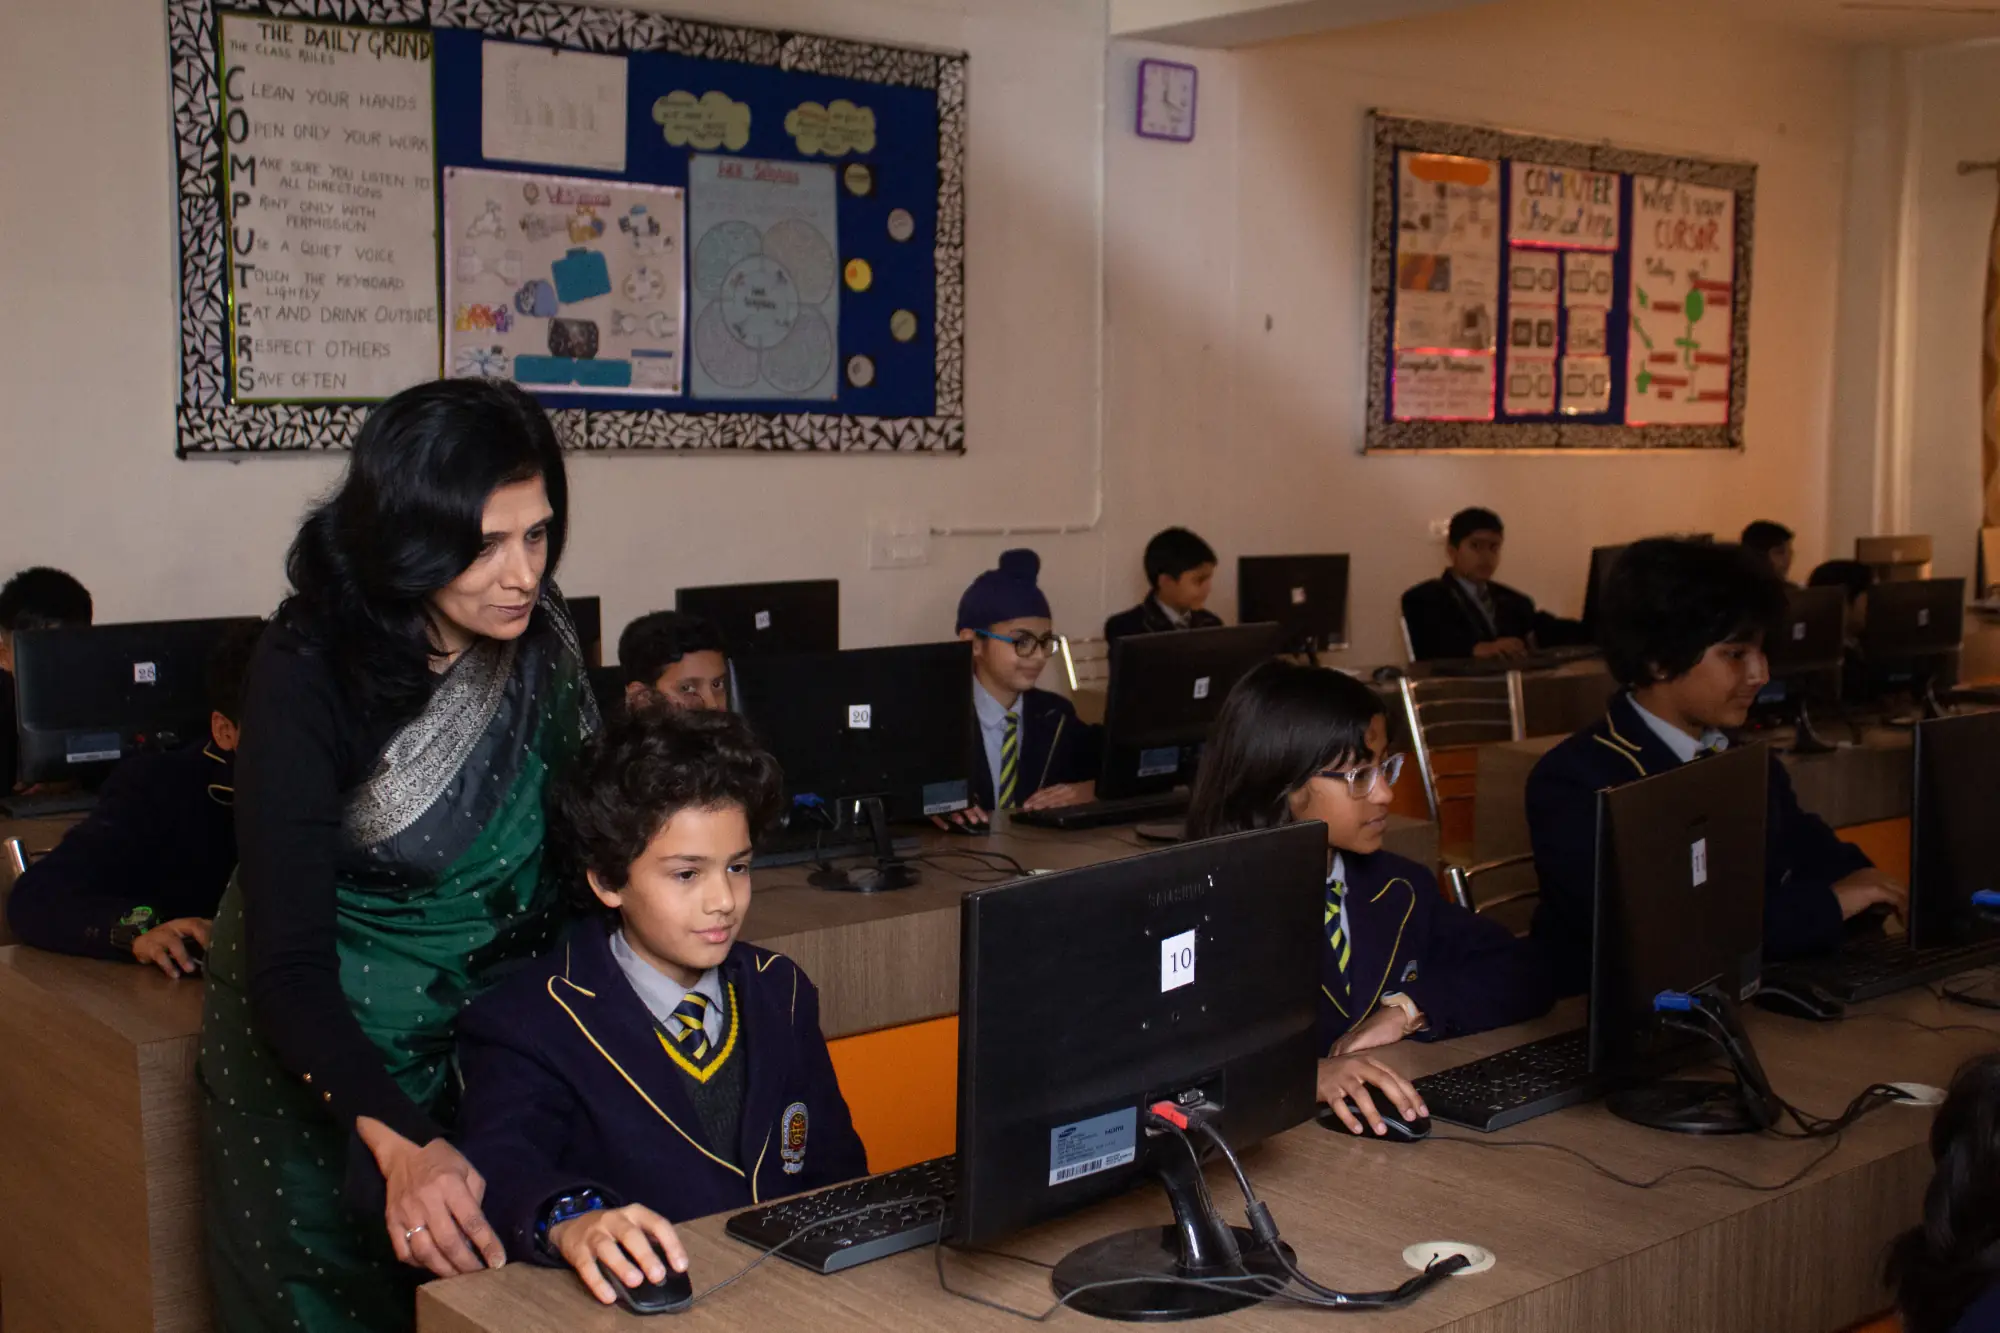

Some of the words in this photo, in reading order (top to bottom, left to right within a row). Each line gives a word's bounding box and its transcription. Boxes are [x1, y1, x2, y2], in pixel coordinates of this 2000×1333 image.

[257, 22, 294, 43] THE
[305, 28, 362, 54] DAILY
[368, 33, 430, 63] GRIND
[305, 88, 351, 110] YOUR
[360, 92, 418, 111] HANDS
[294, 124, 331, 142] ONLY
[342, 126, 382, 147] YOUR
[389, 134, 430, 153] WORK
[290, 160, 321, 175] SURE
[328, 163, 354, 182] YOU
[361, 169, 405, 189] LISTEN
[279, 176, 301, 190] ALL
[307, 178, 384, 201] DIRECTIONS
[1524, 168, 1613, 205] COMPUTER
[300, 200, 335, 215] ONLY
[342, 204, 377, 219] WITH
[286, 214, 368, 233] PERMISSION
[279, 239, 290, 253] A
[301, 239, 343, 259] QUIET
[354, 247, 396, 265] VOICE
[303, 271, 326, 287] THE
[336, 272, 405, 291] KEYBOARD
[275, 305, 311, 322] AND
[320, 305, 368, 324] DRINK
[325, 340, 391, 359] OTHERS
[291, 371, 347, 390] OFTEN
[852, 710, 869, 723] 20
[1169, 947, 1192, 974] 10
